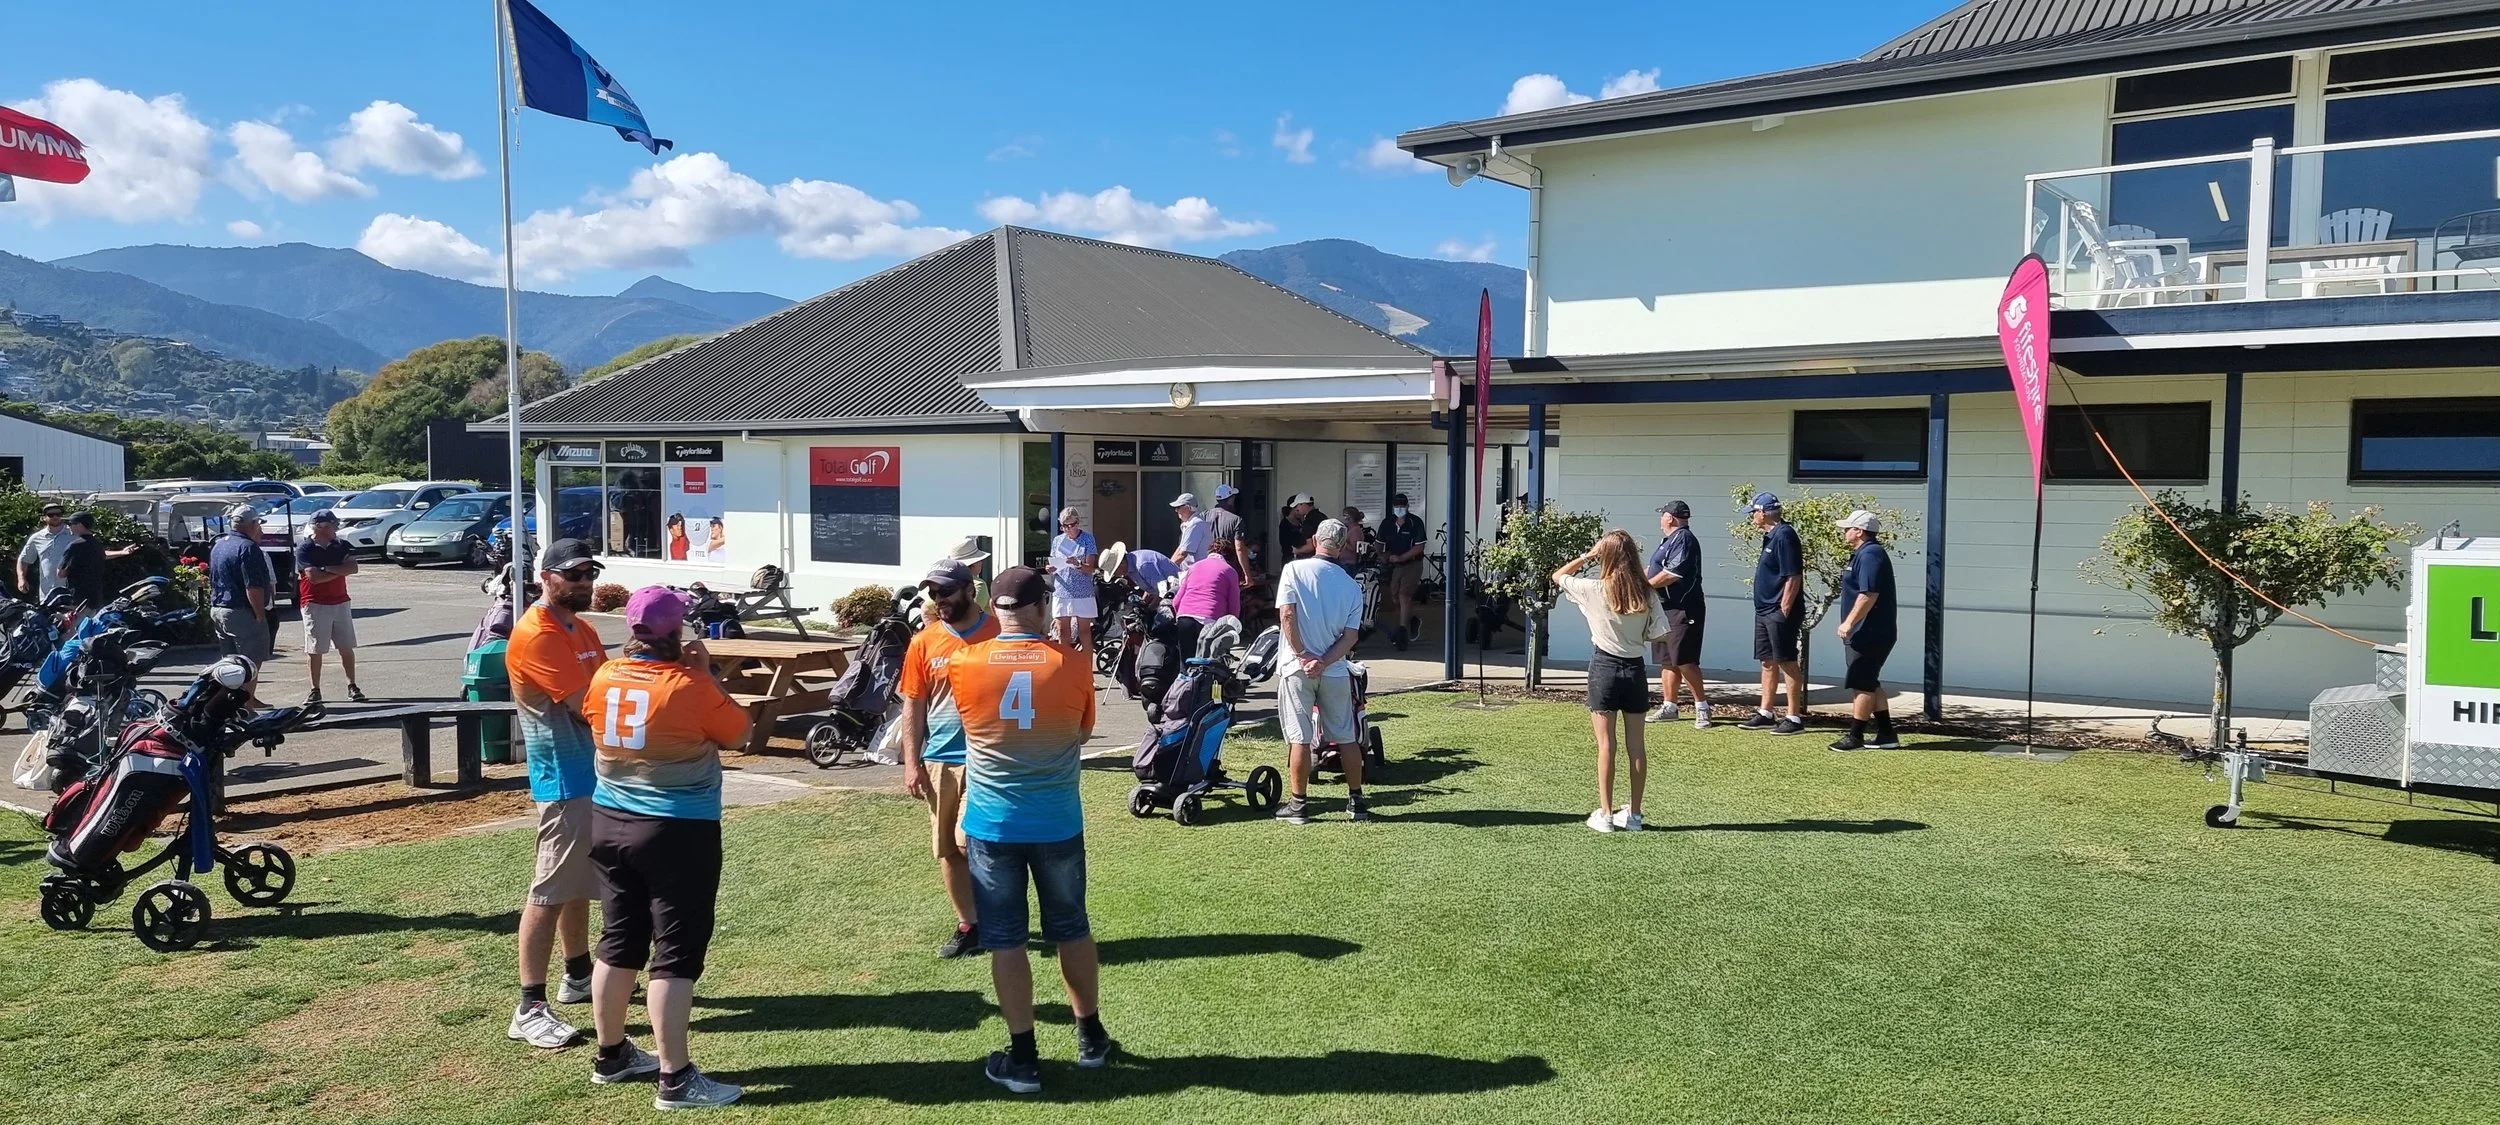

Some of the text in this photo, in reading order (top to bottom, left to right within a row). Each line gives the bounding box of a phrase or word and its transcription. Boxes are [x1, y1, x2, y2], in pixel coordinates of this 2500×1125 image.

[2018, 320, 2042, 426] fifeshire
[620, 442, 648, 459] Callaway
[675, 445, 713, 458] TaylorMade
[1096, 447, 1134, 459] TaylorMade
[819, 458, 876, 475] Total Golf
[1069, 467, 1087, 477] 1862
[999, 670, 1036, 729] 4
[602, 686, 650, 750] 13
[100, 789, 145, 837] Wilson
